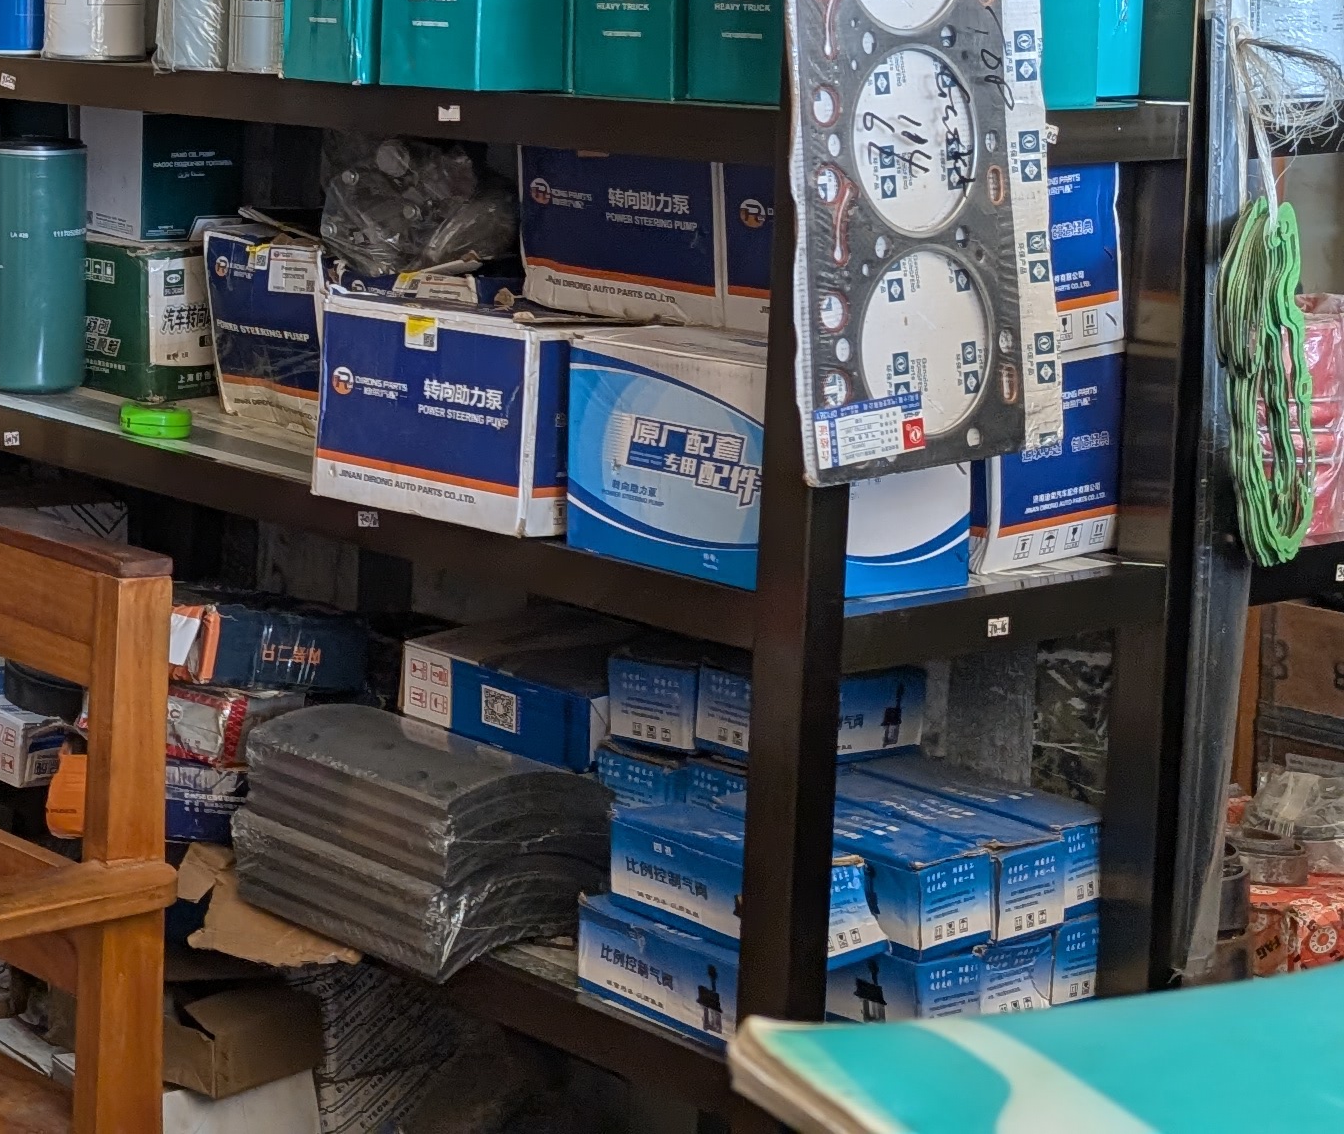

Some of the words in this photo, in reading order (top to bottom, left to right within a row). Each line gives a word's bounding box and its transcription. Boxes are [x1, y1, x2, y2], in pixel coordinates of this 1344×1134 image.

[608, 187, 690, 215] 转向助力泵
[605, 212, 633, 224] POWER
[634, 215, 673, 230] STEERING
[674, 218, 698, 231] PUMP
[592, 284, 615, 295] AUTO
[617, 287, 643, 299] PARTS
[423, 378, 503, 411] 转向助力泵
[417, 403, 445, 418] POWER
[446, 409, 485, 425] STEERING
[632, 417, 745, 463] 原厂配套
[339, 470, 362, 481] JINAN
[363, 473, 393, 487] DIRONG
[394, 480, 416, 492] AUTO
[417, 484, 442, 497] PARTS
[664, 453, 762, 508] 专用配件
[625, 856, 709, 901] 比例控制气阀
[1255, 935, 1281, 963] FAG
[601, 943, 674, 991] 比例控制气阀
